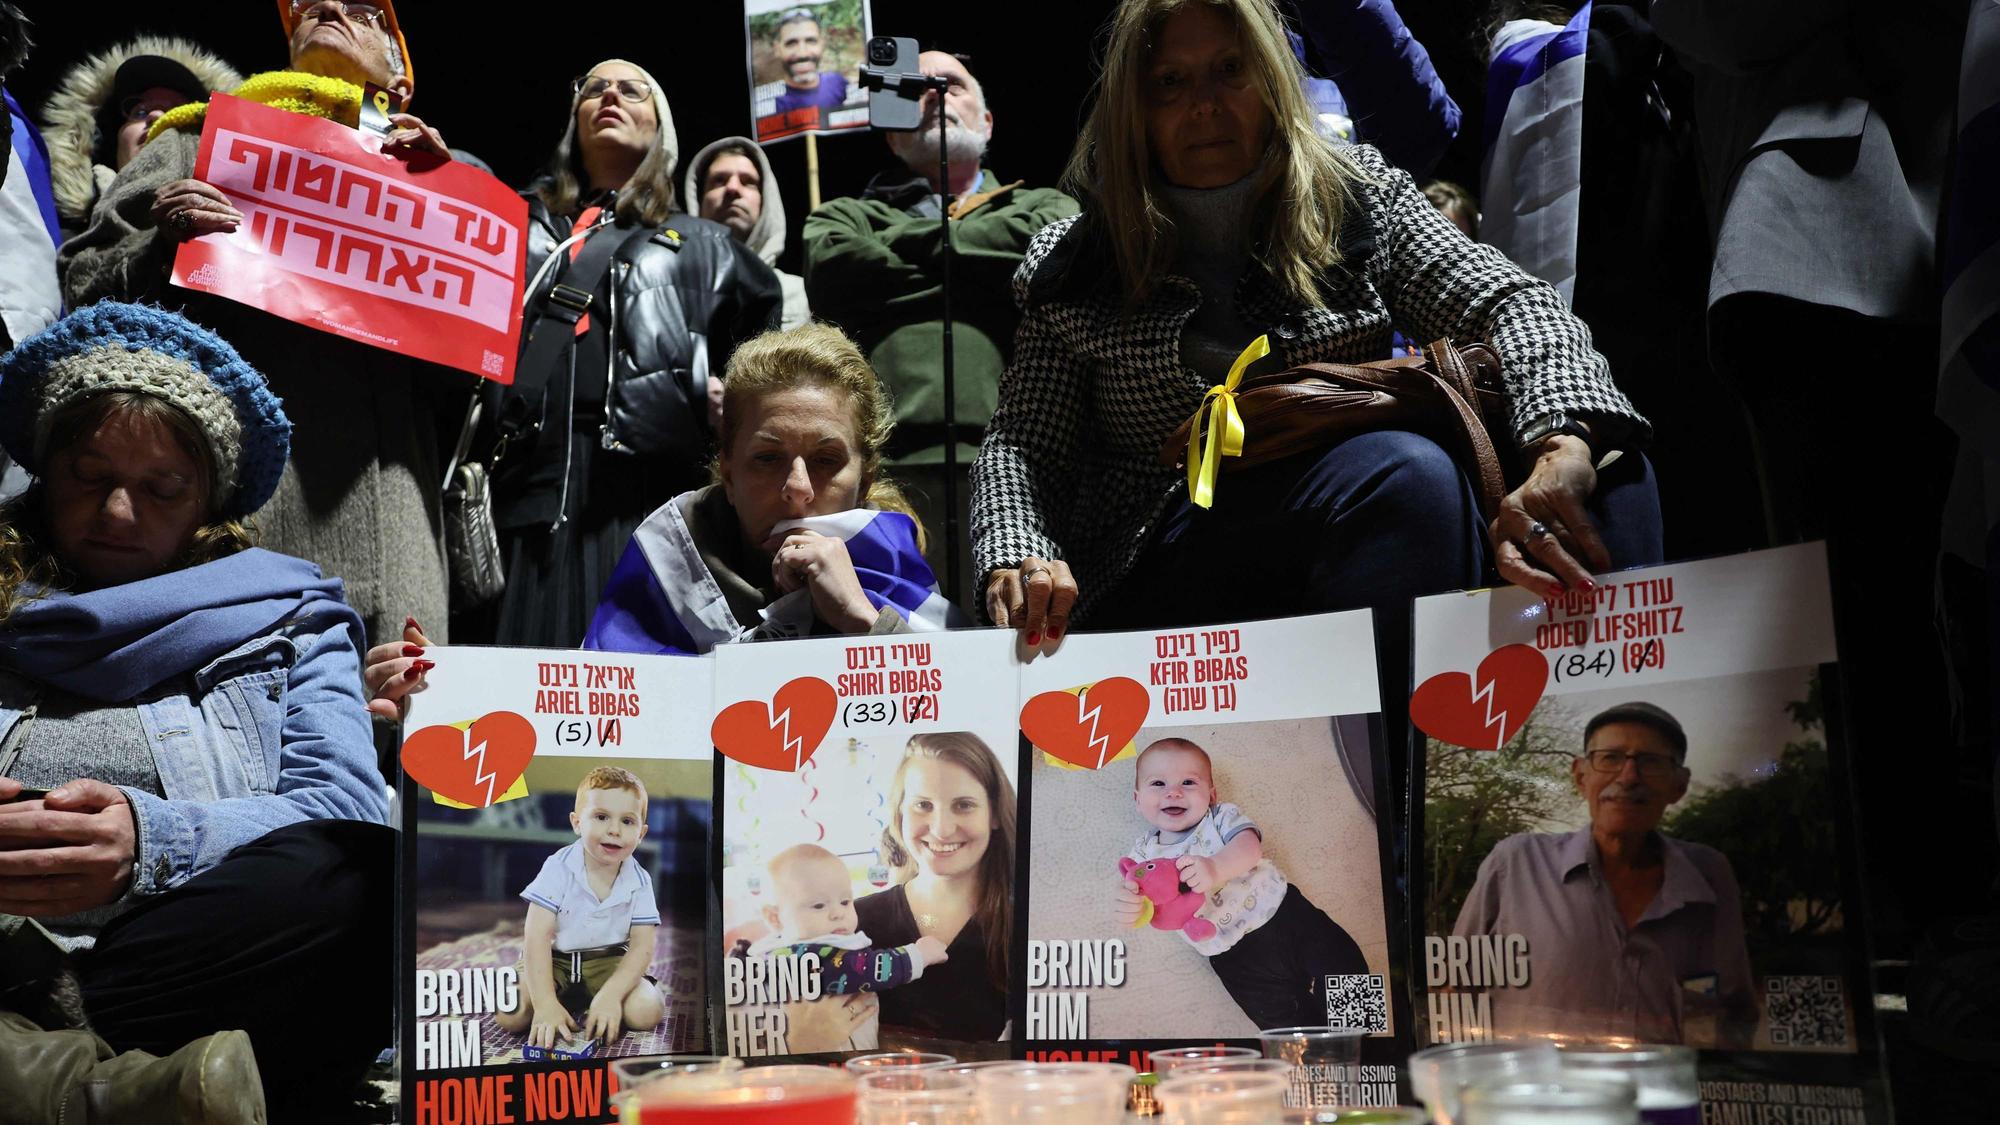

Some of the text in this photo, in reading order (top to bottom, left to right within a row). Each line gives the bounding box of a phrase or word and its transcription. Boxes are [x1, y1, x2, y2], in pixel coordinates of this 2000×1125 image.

[229, 138, 507, 257] עד החטוף
[251, 211, 475, 307] האחרון
[1623, 577, 1674, 609] עודד
[1155, 629, 1241, 659] כפיר ביבס
[1536, 606, 1685, 650] ODED LIFSHITZ
[538, 662, 636, 690] אריאל ביבס
[845, 643, 932, 670] שירי ביבס
[1150, 655, 1249, 686] KFIR BIBAS
[1554, 648, 1615, 683] (84)
[535, 689, 640, 717] ARIEL BIBAS
[837, 668, 943, 698] SHIRI BIBAS
[555, 719, 592, 747] (5)
[843, 699, 897, 728] (33)
[724, 951, 822, 1006] BRING
[1027, 938, 1126, 988] BRING
[1425, 933, 1529, 987] BRING
[416, 966, 519, 1018] BRING
[727, 1005, 790, 1058] HER
[1027, 991, 1088, 1041] HIM
[1427, 992, 1494, 1045] HIM
[416, 1019, 481, 1072] HIM
[416, 1074, 514, 1125] HOME
[1768, 1083, 1796, 1104] AND
